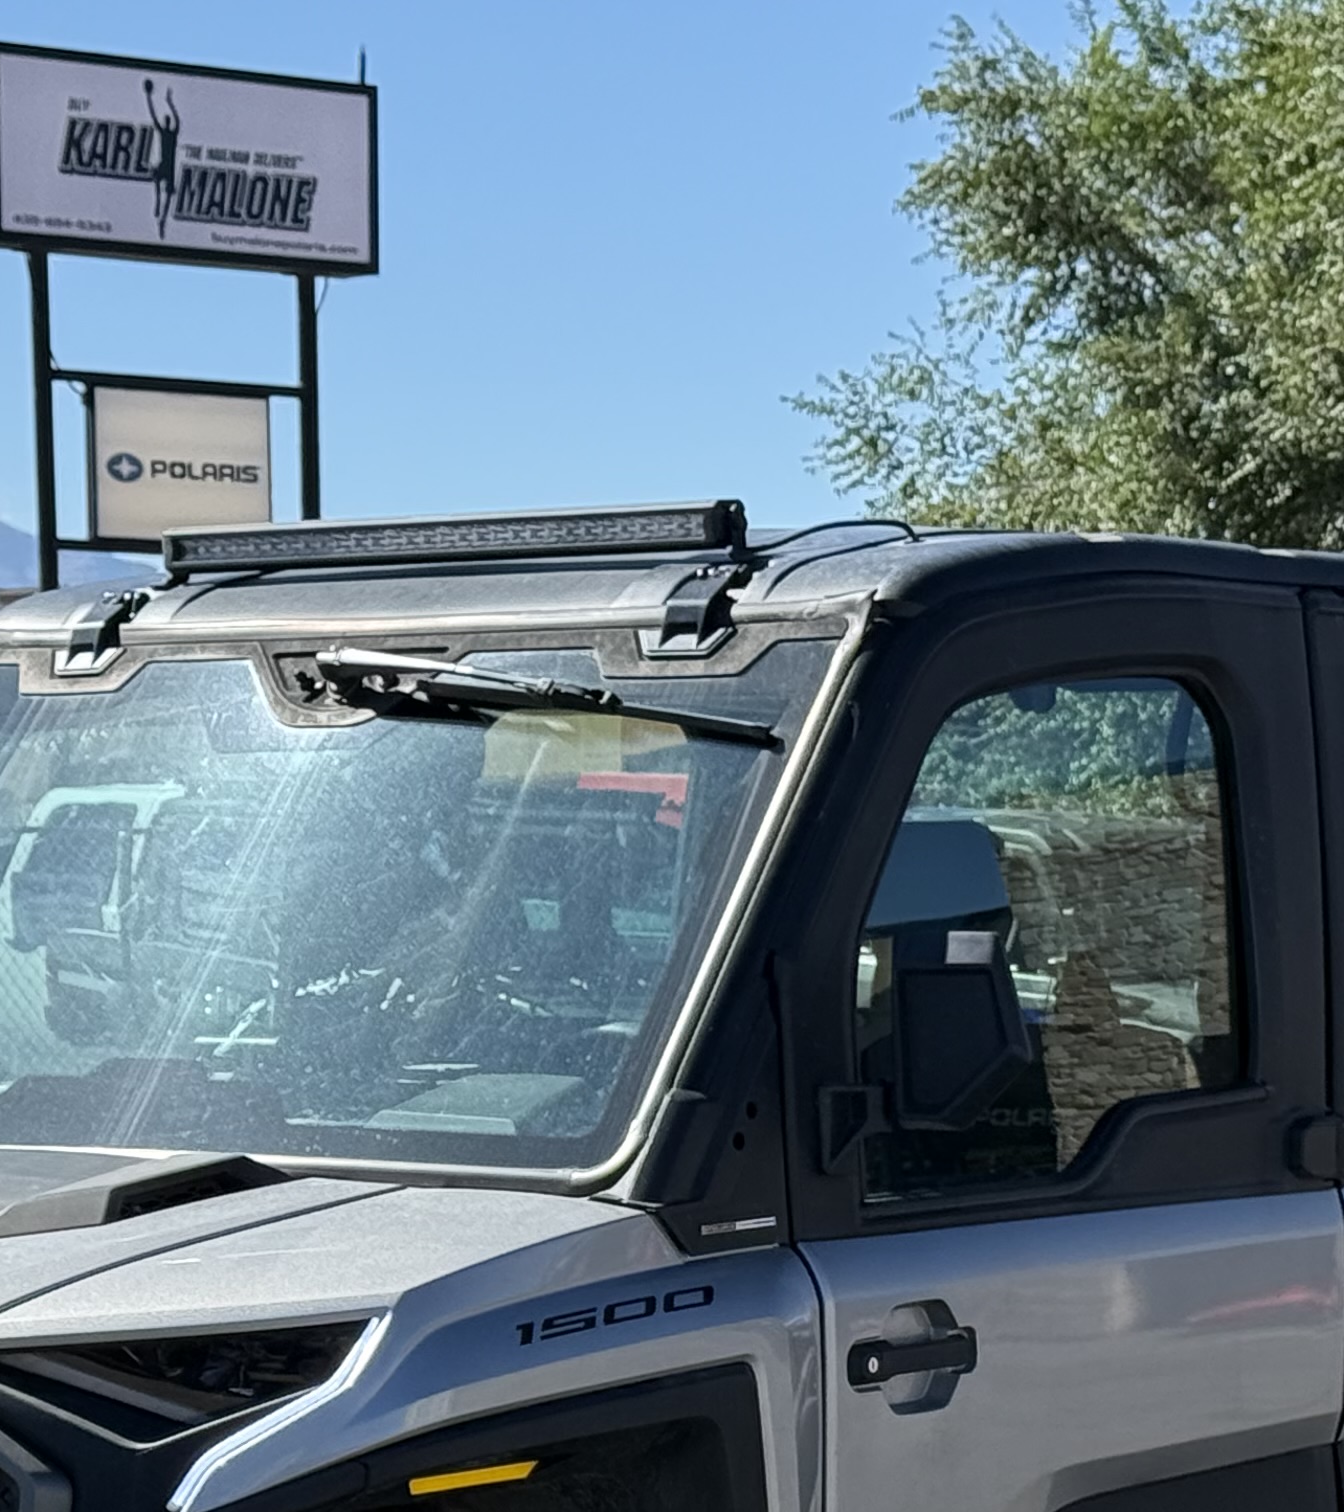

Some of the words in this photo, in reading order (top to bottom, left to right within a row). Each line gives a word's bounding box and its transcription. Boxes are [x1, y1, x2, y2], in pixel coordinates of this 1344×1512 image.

[60, 118, 154, 178] KARL
[174, 164, 315, 228] MALONE
[150, 459, 260, 483] POLARIS
[515, 1285, 714, 1347] 1500
